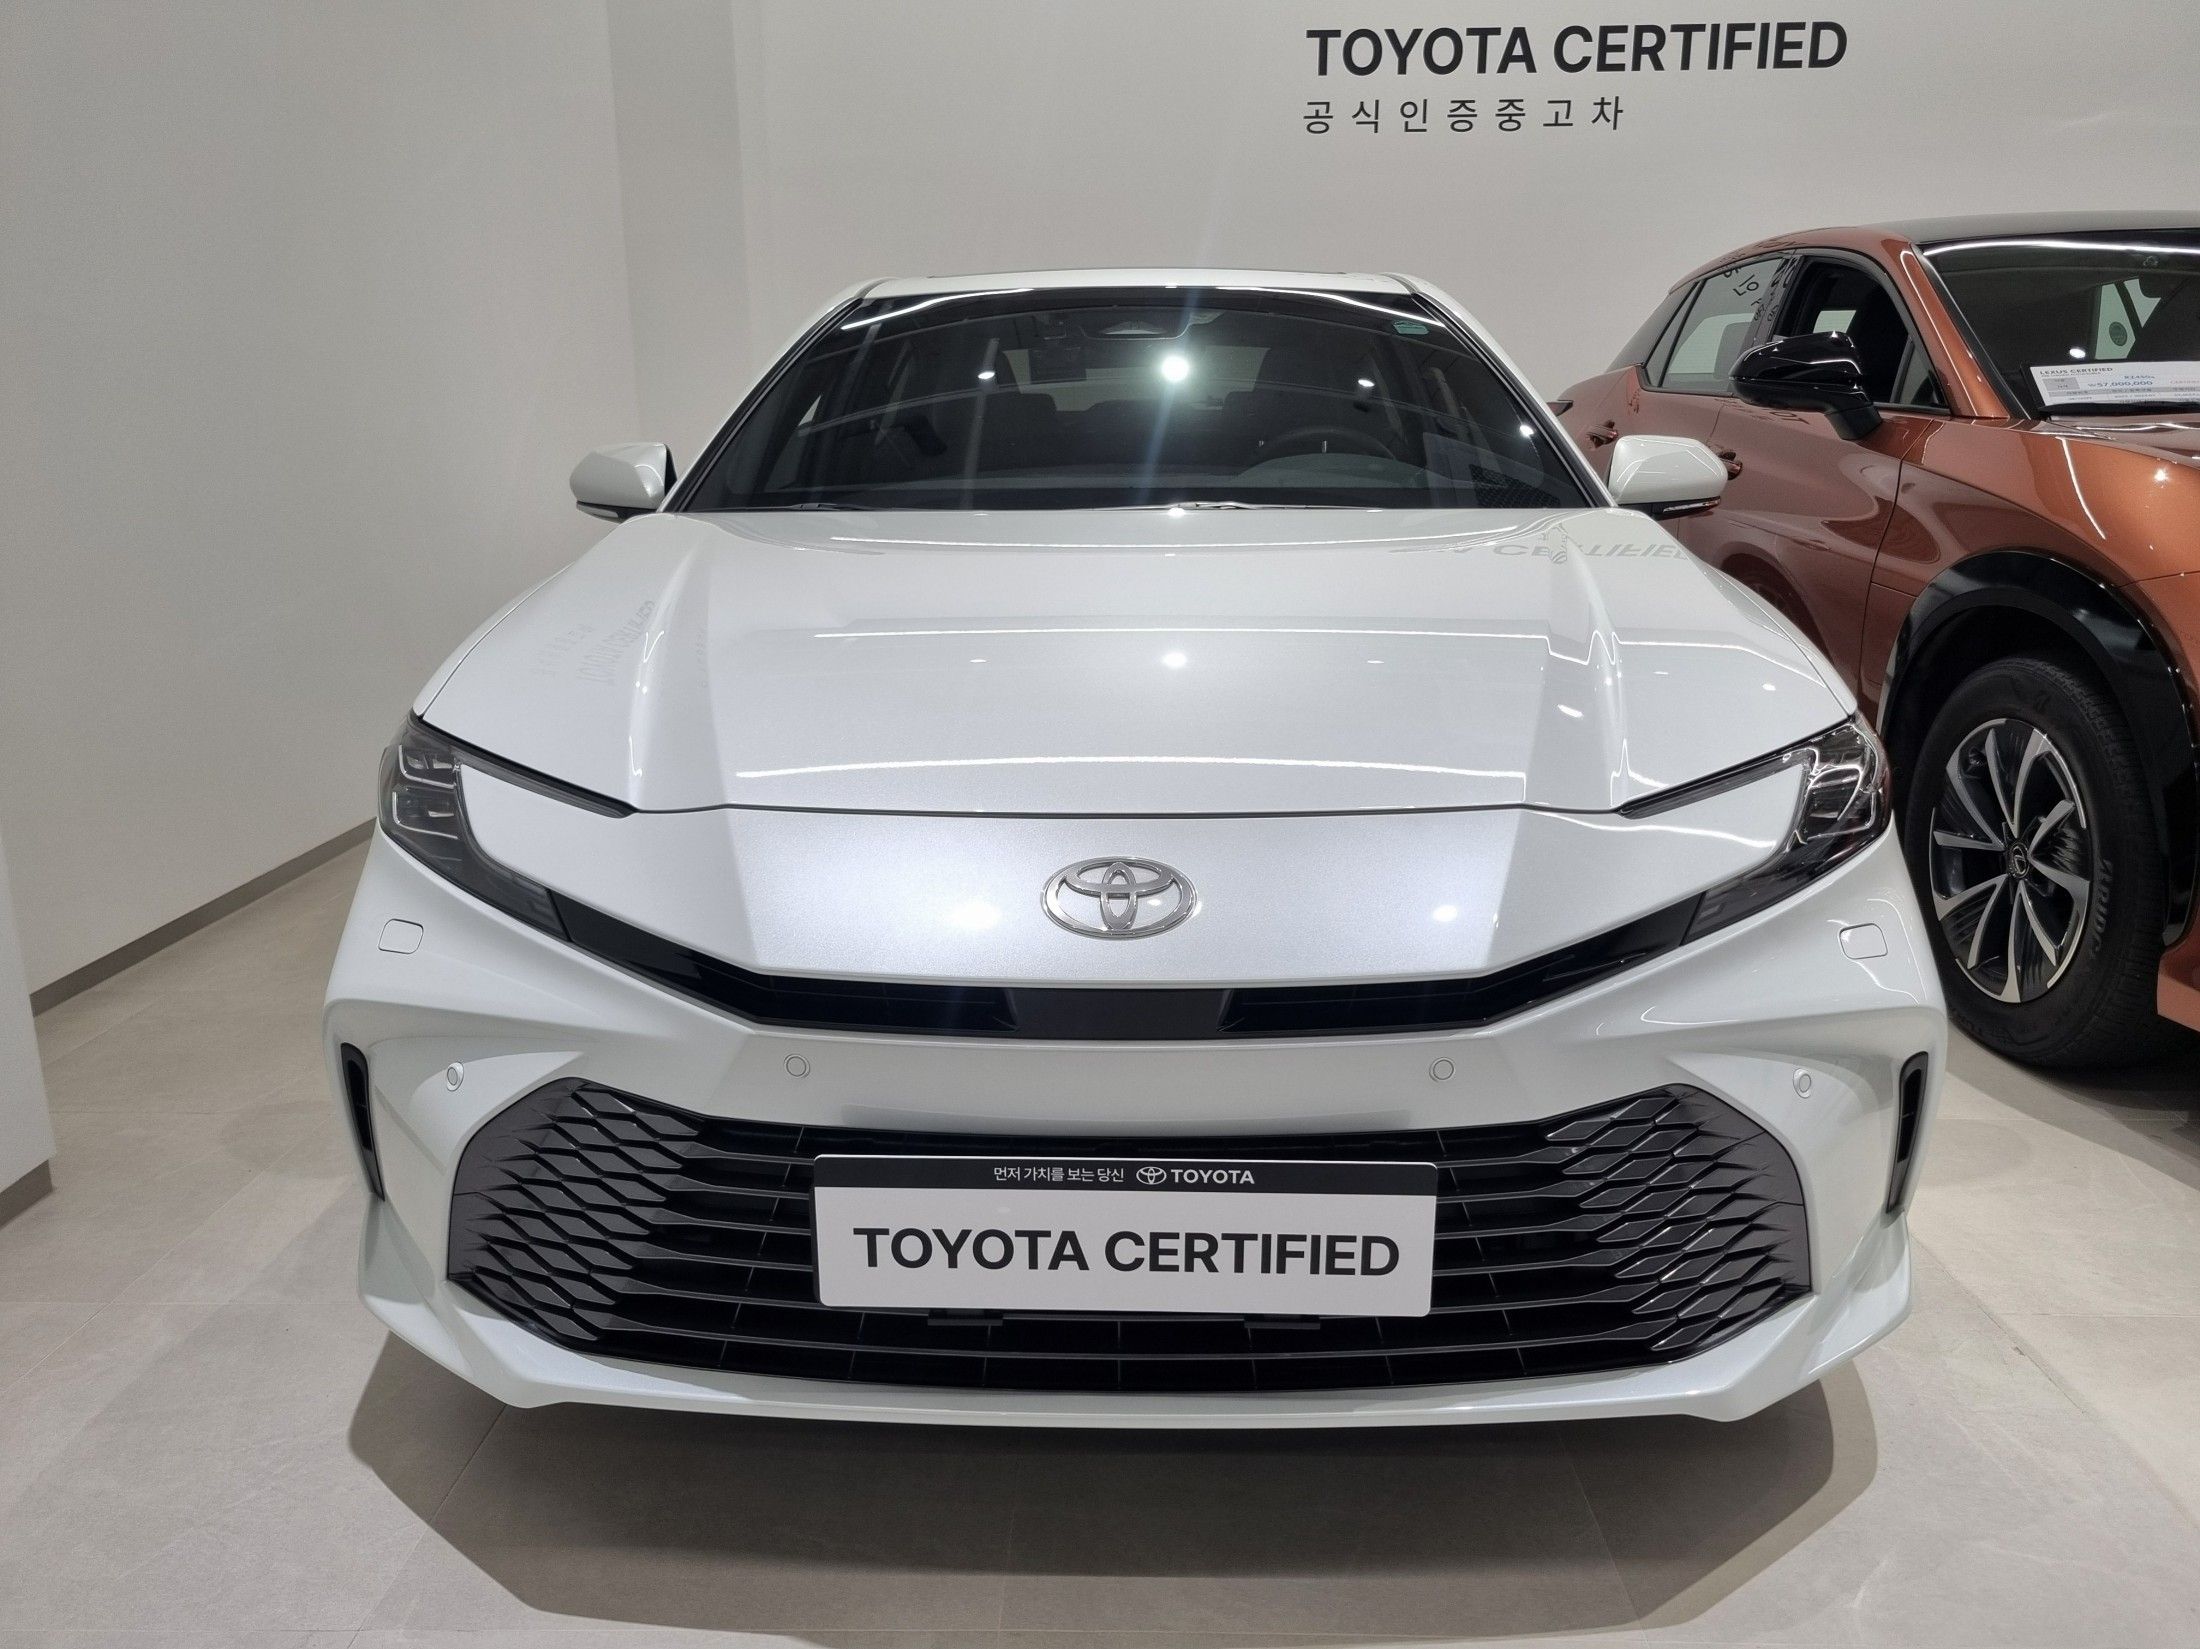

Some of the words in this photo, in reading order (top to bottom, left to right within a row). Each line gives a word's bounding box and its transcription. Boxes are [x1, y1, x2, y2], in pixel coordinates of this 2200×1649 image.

[1307, 27, 1536, 76] TOYOTA
[1554, 22, 1847, 73] CERTIFIED
[1304, 96, 1623, 134] 공식인증중고차
[994, 1167, 1020, 1180] 먼저
[1024, 1167, 1064, 1181] 가치를
[1068, 1168, 1094, 1181] 보는
[1098, 1168, 1123, 1182] 당신
[1171, 1169, 1254, 1184] TOYOTA
[853, 1228, 1089, 1270] TOYOTA
[1105, 1231, 1399, 1275] CERTIFIED
